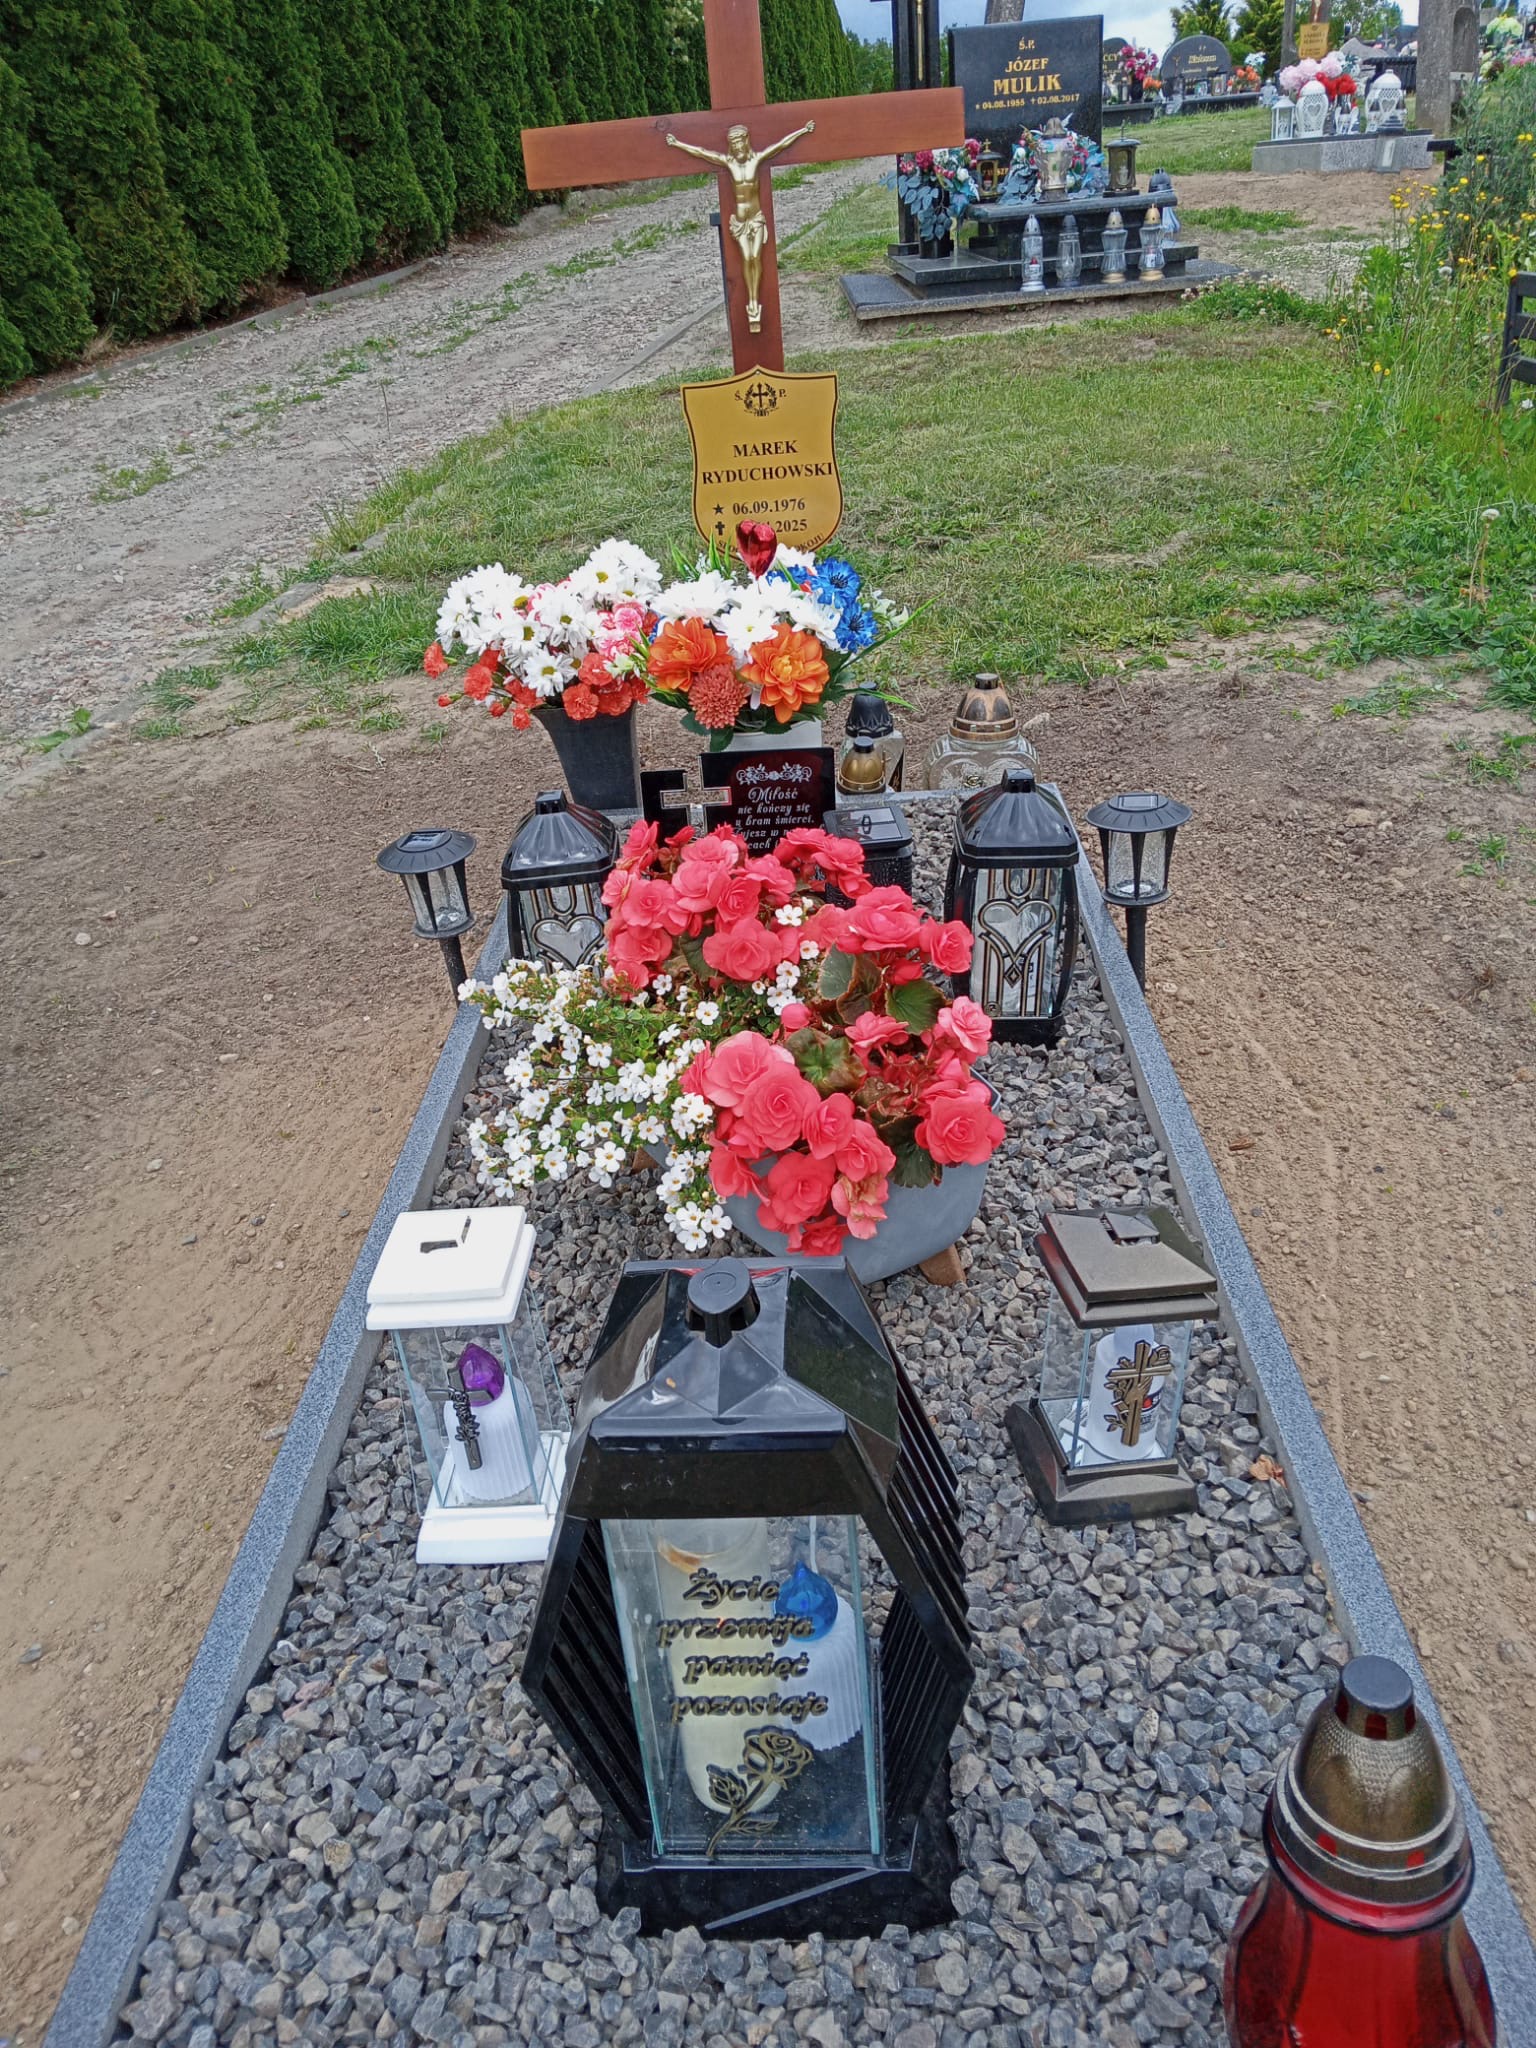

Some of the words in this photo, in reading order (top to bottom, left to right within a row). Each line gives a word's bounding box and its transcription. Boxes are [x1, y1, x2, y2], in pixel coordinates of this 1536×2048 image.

[1005, 56, 1049, 73] JÓZEF
[993, 74, 1062, 97] MULIK
[733, 440, 798, 458] MAREK
[702, 462, 833, 485] RYDUCHOWSKI
[732, 498, 806, 515] 06.09.1976
[748, 786, 799, 804] Miłość
[738, 805, 753, 815] nie
[757, 802, 792, 816] kończy
[796, 803, 811, 814] się
[746, 815, 771, 826] bram
[770, 829, 779, 837] w
[747, 838, 770, 849] cach
[683, 1567, 780, 1609] Życie
[656, 1613, 816, 1648] przemija
[682, 1651, 810, 1684] pamięć
[670, 1691, 829, 1725] pozostaje
